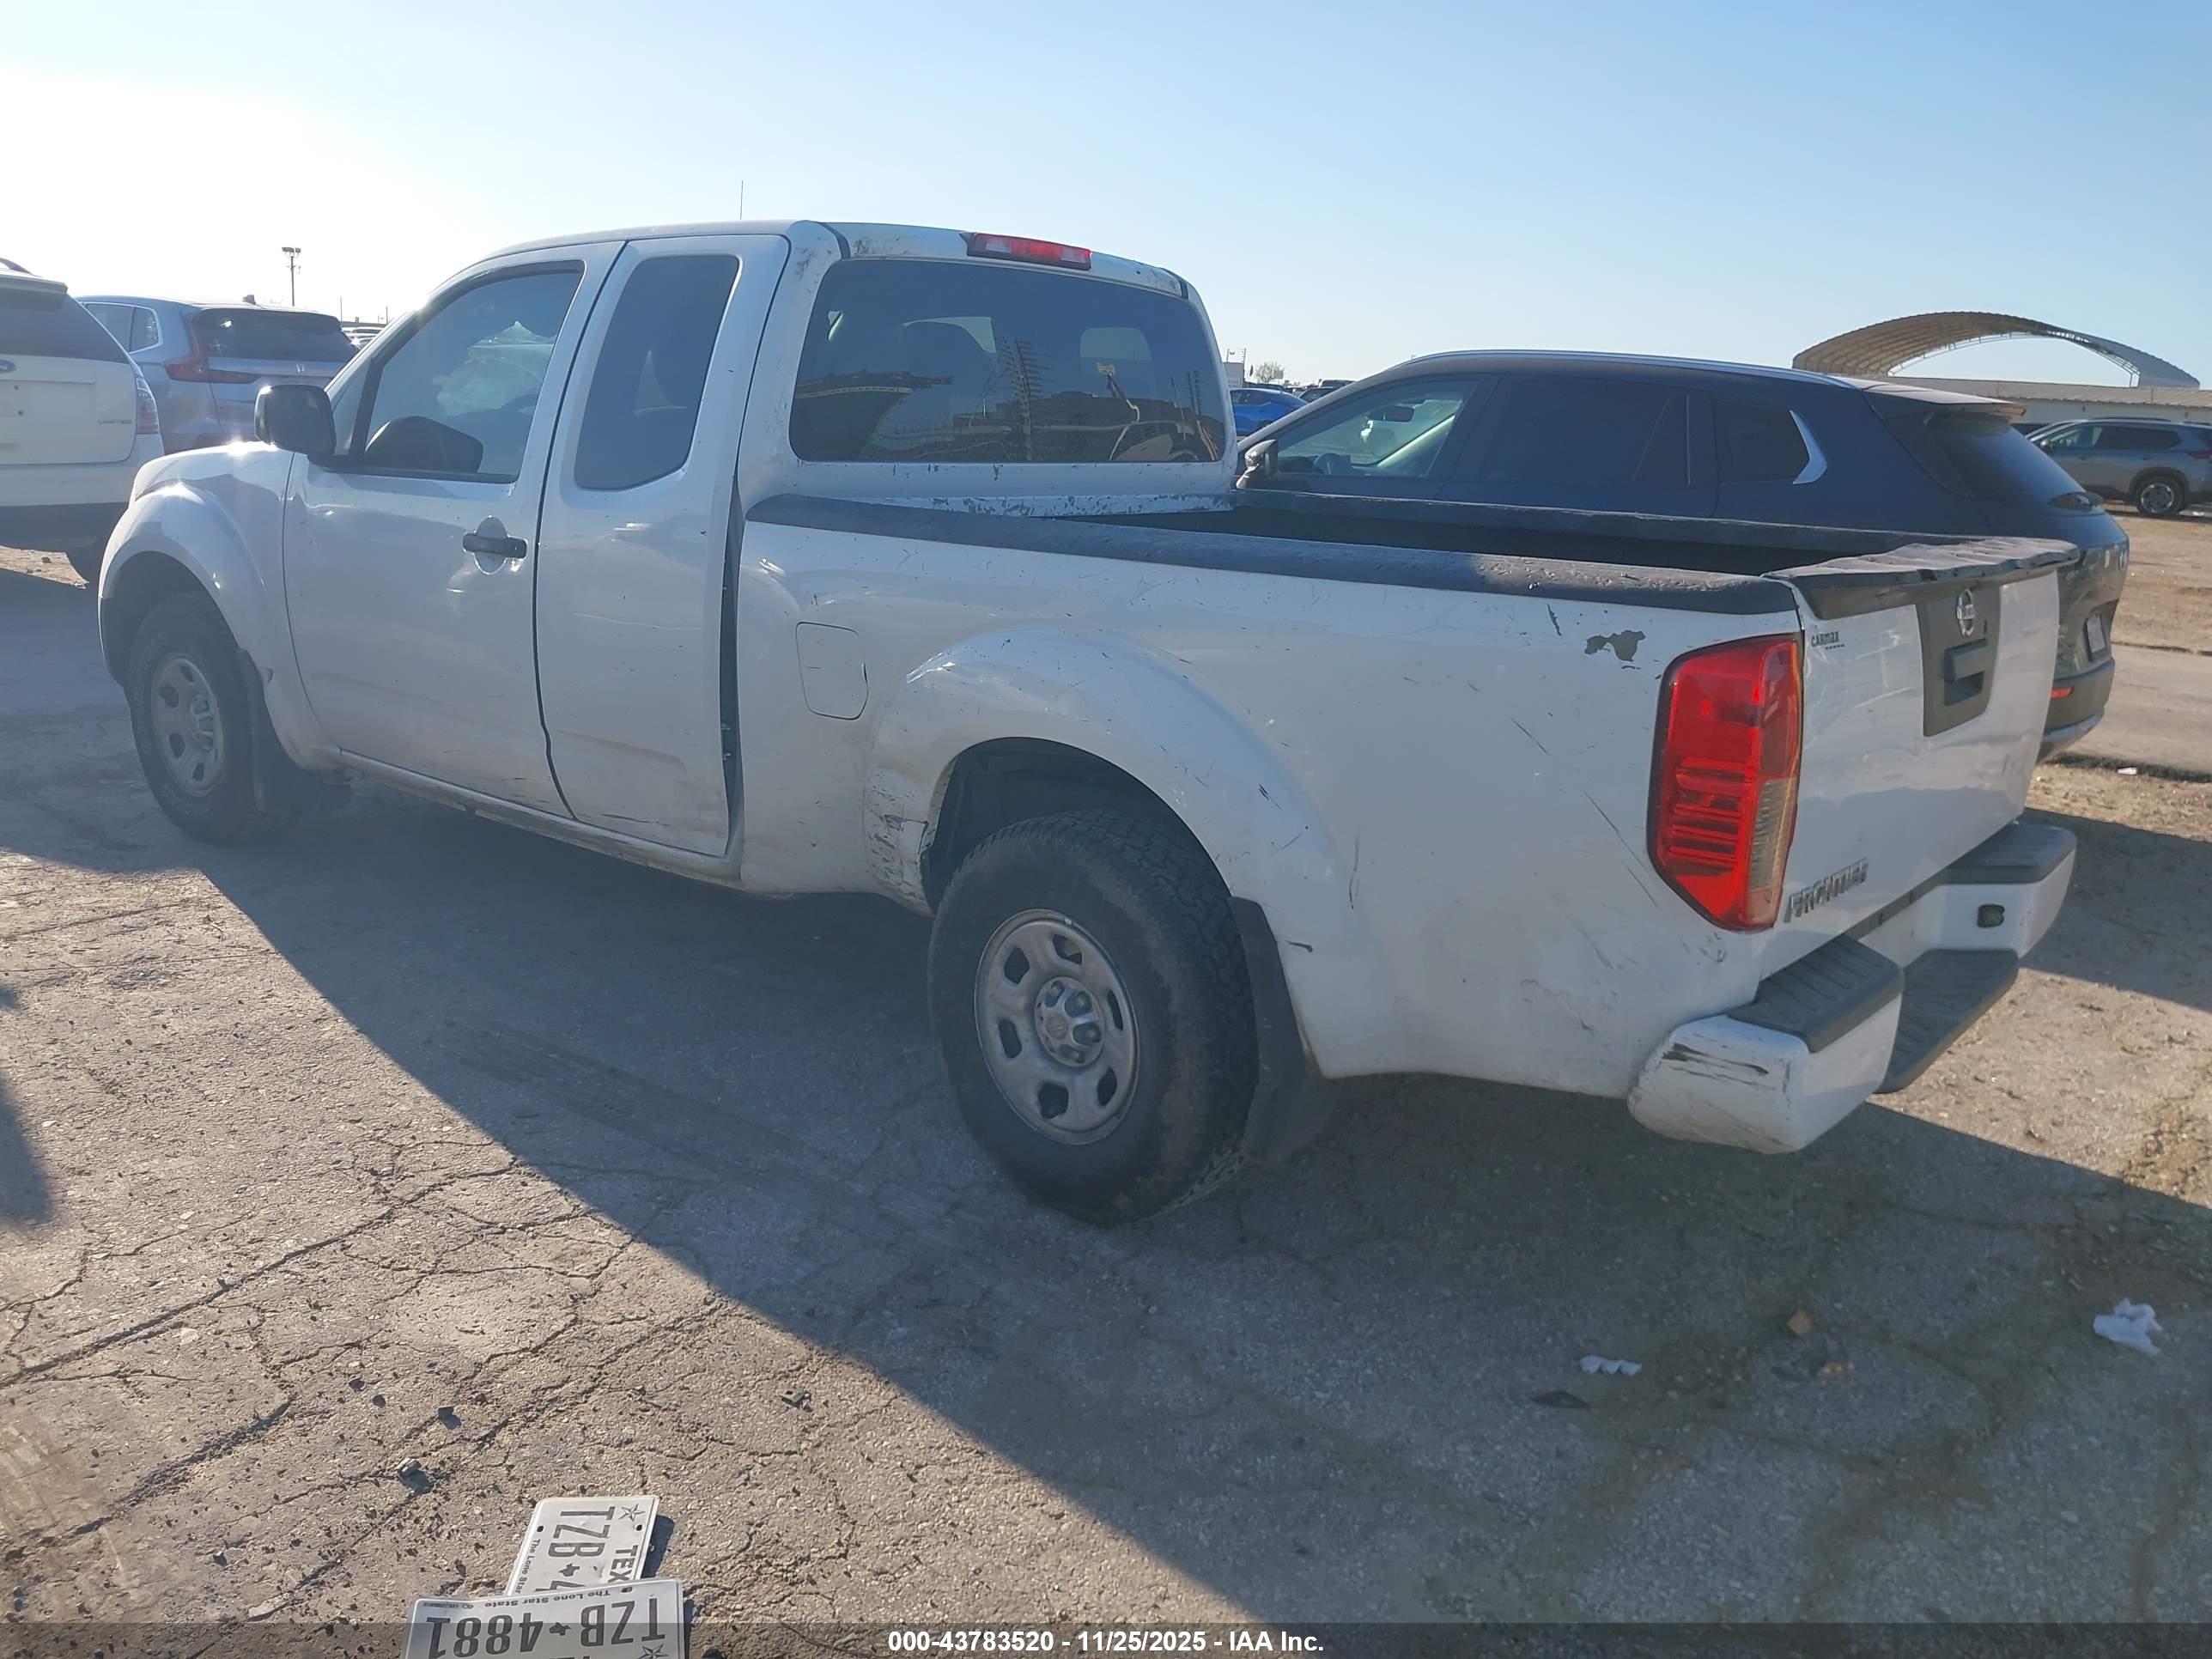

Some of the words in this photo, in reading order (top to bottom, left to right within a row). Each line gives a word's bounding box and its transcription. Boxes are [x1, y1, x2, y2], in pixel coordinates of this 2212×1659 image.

[529, 1538, 541, 1553] The
[548, 1506, 616, 1557] TZB
[521, 1555, 536, 1575] Lone
[515, 1577, 527, 1595] Star
[426, 1613, 544, 1658] 4881
[580, 1598, 665, 1647] TZB
